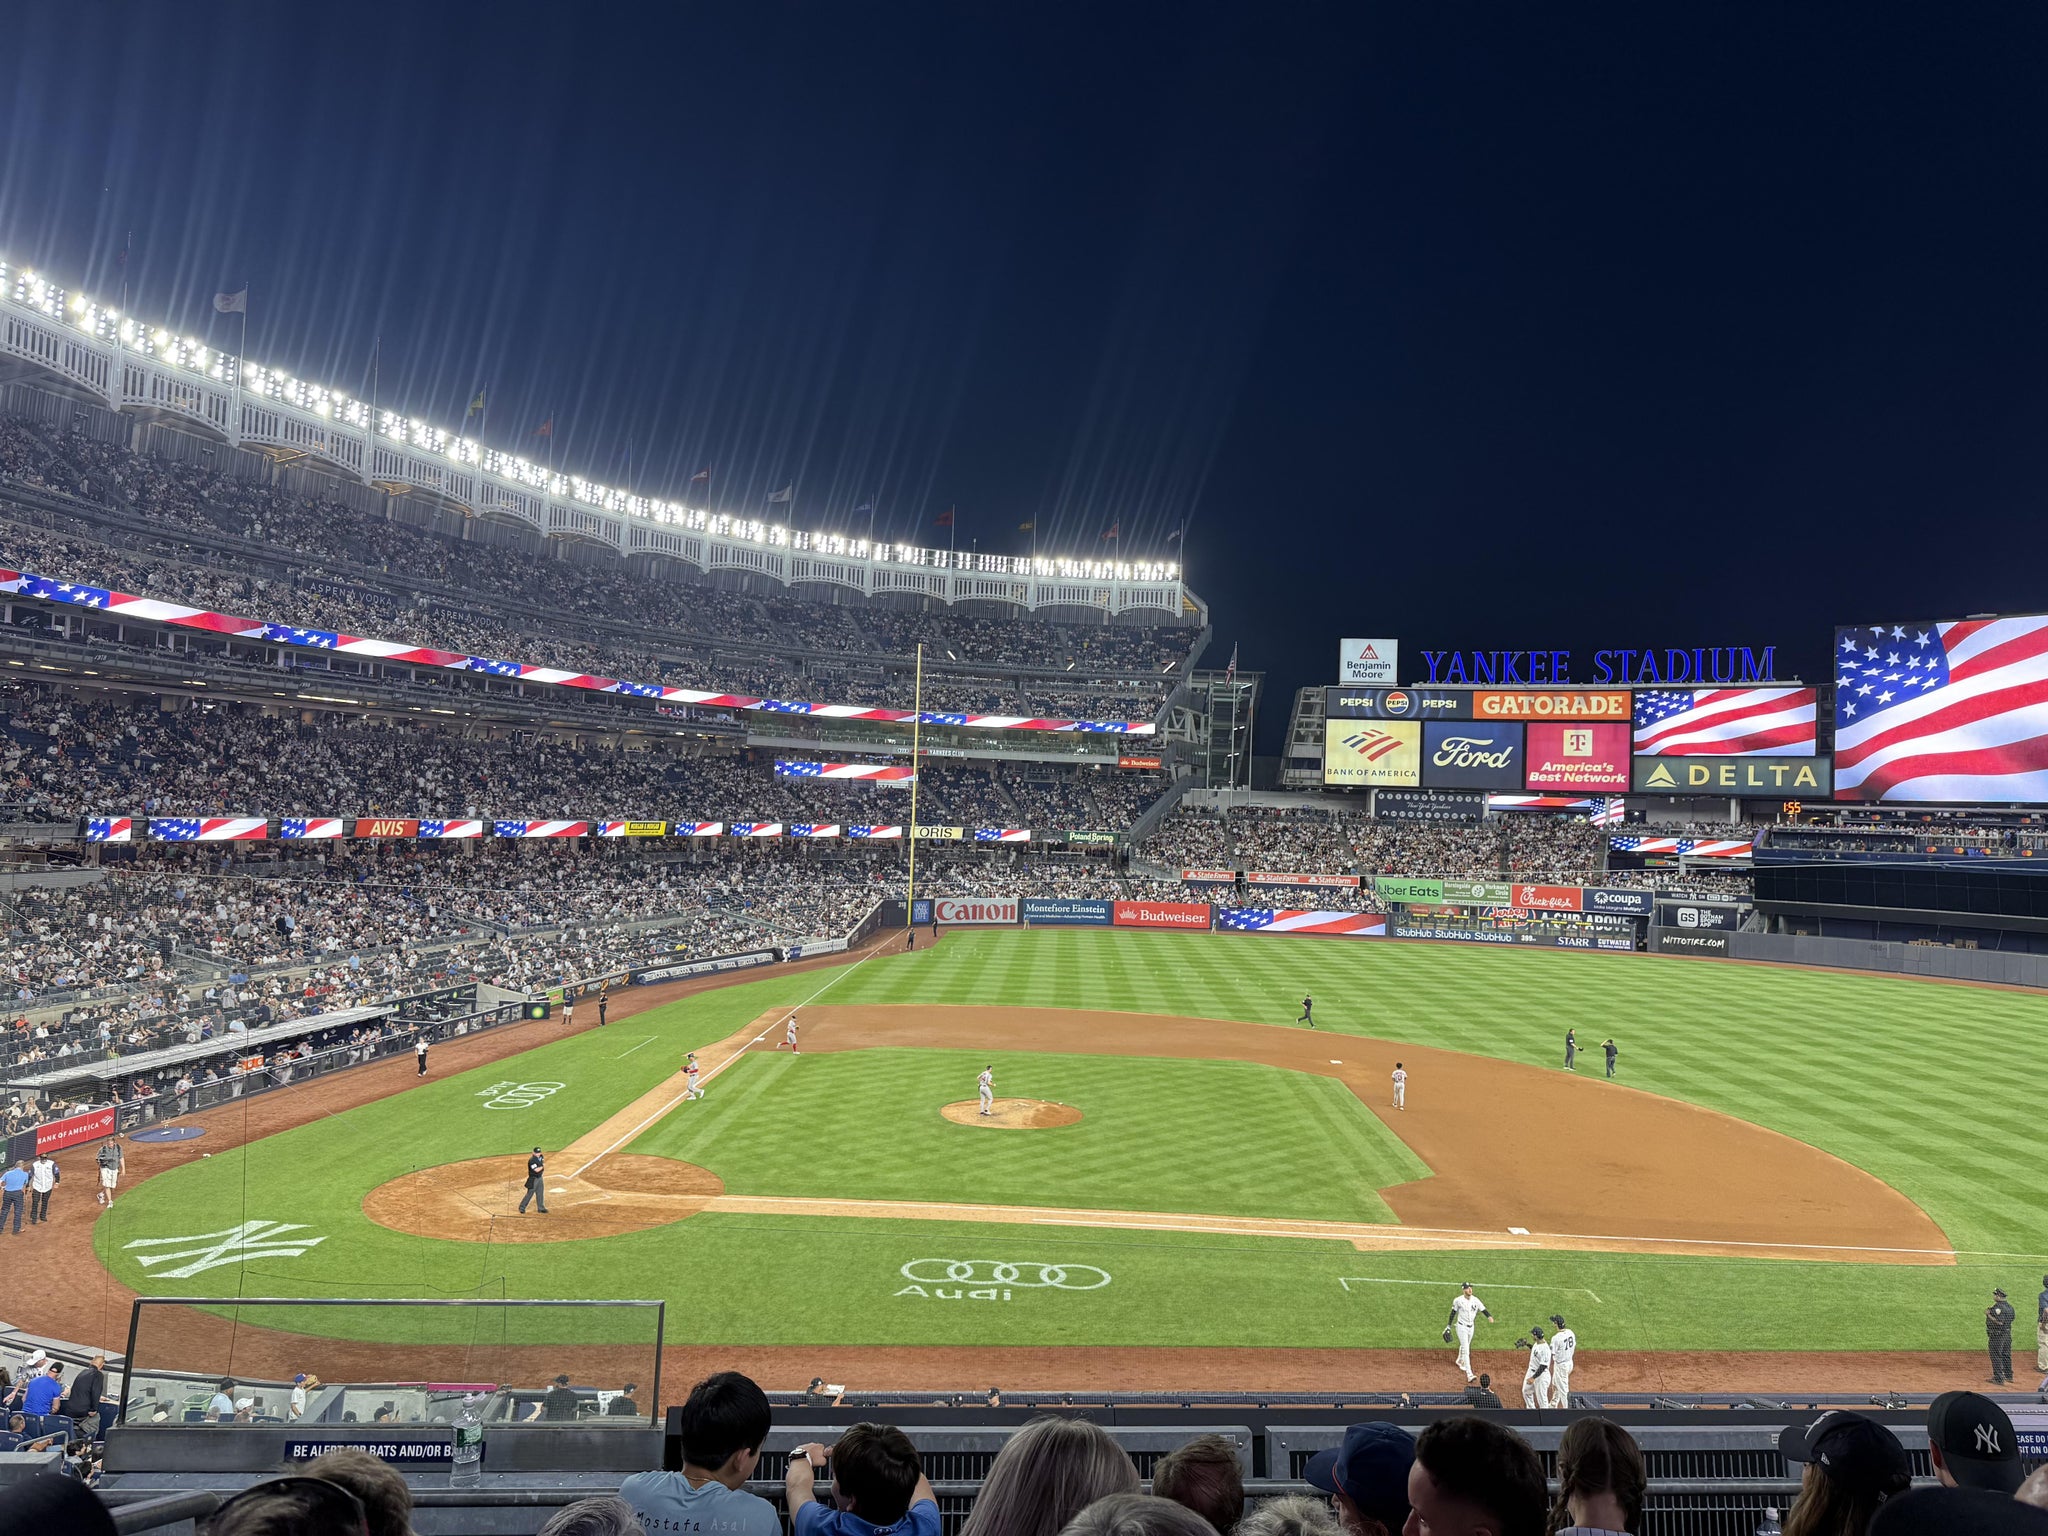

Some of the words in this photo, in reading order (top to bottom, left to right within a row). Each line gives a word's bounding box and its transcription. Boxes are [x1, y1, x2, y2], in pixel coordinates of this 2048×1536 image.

[1347, 661, 1391, 671] Benjamin
[1420, 650, 1570, 684] YANKEE
[1593, 646, 1777, 684] STADIUM
[1352, 670, 1384, 679] Moore
[1340, 698, 1373, 707] PEPSI
[1422, 700, 1457, 709] PEPSI
[1483, 696, 1623, 715] GATORADE
[1432, 737, 1514, 769] Ford
[1131, 759, 1160, 767] Budweiser
[1541, 762, 1615, 772] America's
[1327, 768, 1354, 776] BANK
[1529, 772, 1562, 782] Best
[1563, 773, 1626, 783] Network
[1689, 765, 1818, 787] DELTA
[369, 821, 404, 836] AVIS
[919, 827, 953, 838] ORIS
[1070, 832, 1091, 840] Poland
[1091, 833, 1114, 842] Spring
[1409, 886, 1439, 897] Eats
[1520, 887, 1573, 908] Chick-fil-A
[1609, 894, 1642, 906] coupa
[936, 901, 1015, 920] Canon
[1026, 903, 1070, 912] Montefiore
[1072, 904, 1106, 913] Einstein
[1490, 907, 1529, 919] Jersey
[1681, 913, 1695, 922] GS
[1397, 928, 1432, 938] StubHub
[1435, 929, 1471, 940] StubHub
[1474, 931, 1512, 942] StubHub
[1557, 936, 1589, 947] STARR
[1662, 935, 1725, 948] NITTOTIRE.COM
[37, 1133, 57, 1145] BANK
[57, 1131, 67, 1139] OF
[68, 1121, 100, 1137] AMERICA
[893, 1285, 1012, 1301] Audi
[1563, 1336, 1574, 1351] 78
[2035, 1435, 2045, 1444] DO
[293, 1445, 308, 1457] BE
[369, 1445, 397, 1457] BATS
[399, 1445, 441, 1458] AND/OR
[2030, 1445, 2041, 1454] ON
[636, 1511, 700, 1532] Mostafa
[710, 1517, 747, 1532] Asal
